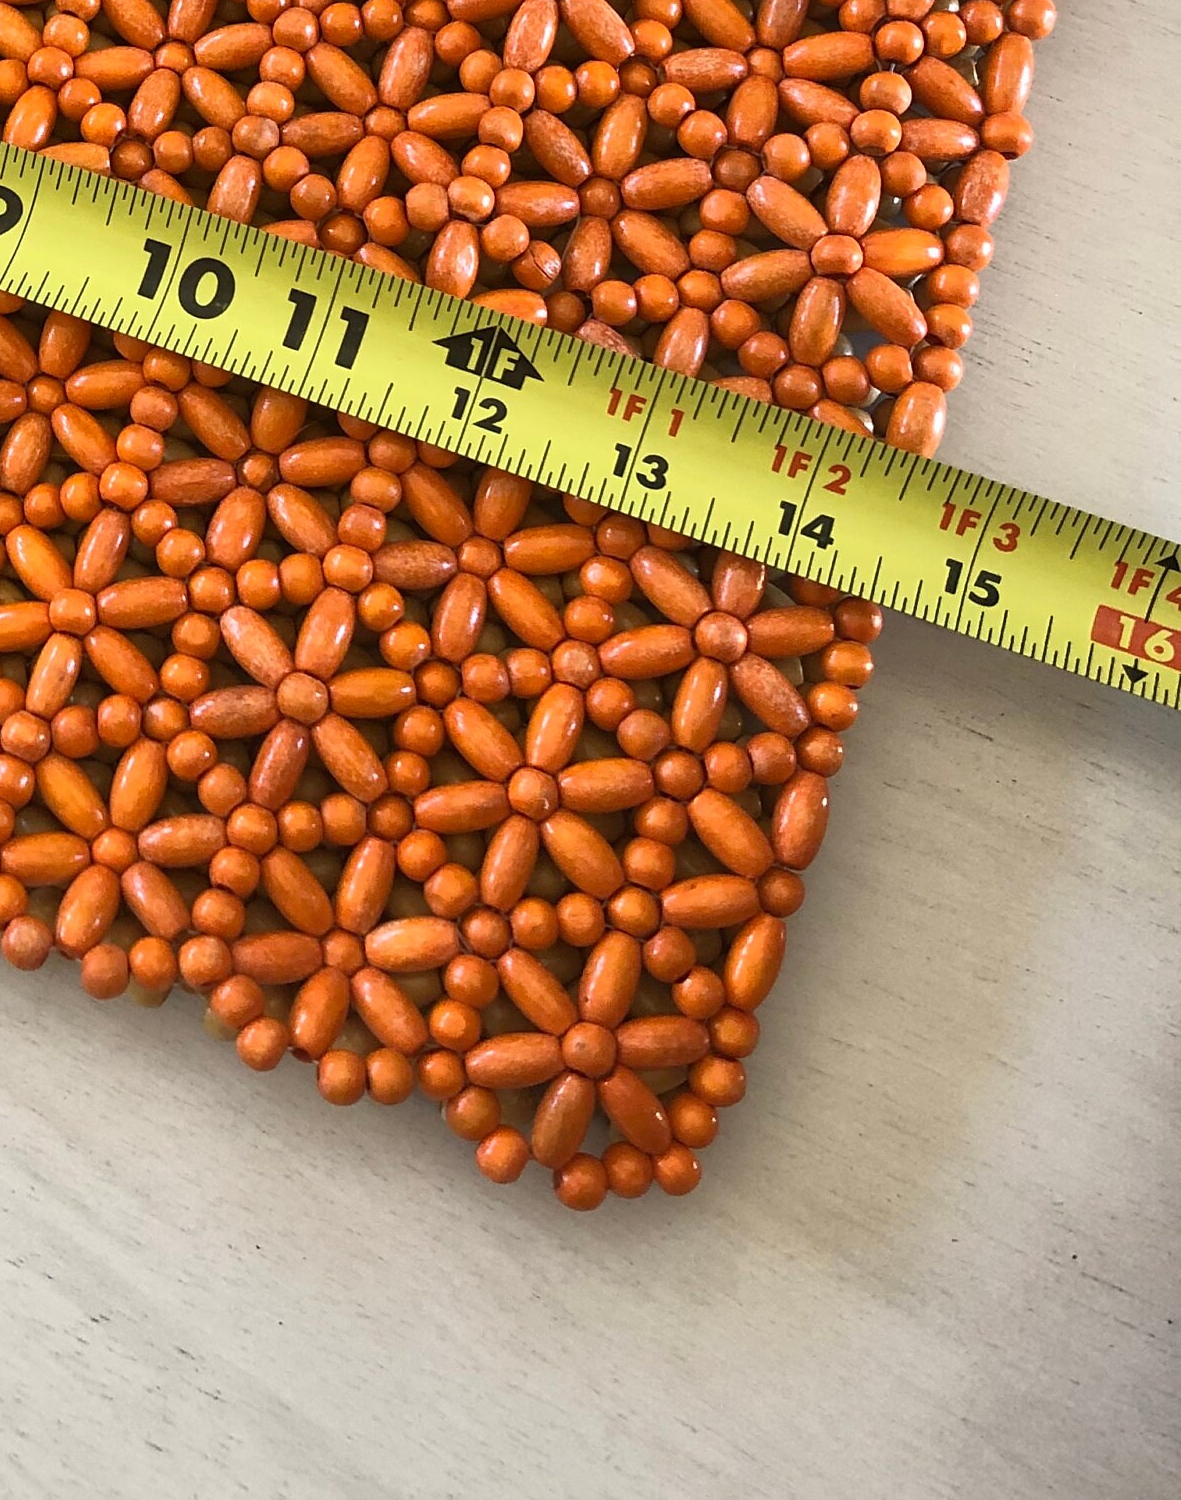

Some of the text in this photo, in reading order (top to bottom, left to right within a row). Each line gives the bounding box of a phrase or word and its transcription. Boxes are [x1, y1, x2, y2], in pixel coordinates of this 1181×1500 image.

[137, 238, 236, 319] 10
[282, 288, 370, 370] 11
[465, 337, 521, 379] 1F
[451, 386, 509, 434] 12
[605, 388, 686, 438] 1F 1
[613, 443, 670, 491] 13
[771, 445, 852, 495] 1F 2
[777, 501, 835, 550] 14
[939, 503, 1021, 552] 1F 3
[944, 558, 1003, 607] 15
[1110, 561, 1156, 595] 1F
[1119, 615, 1175, 662] 16
